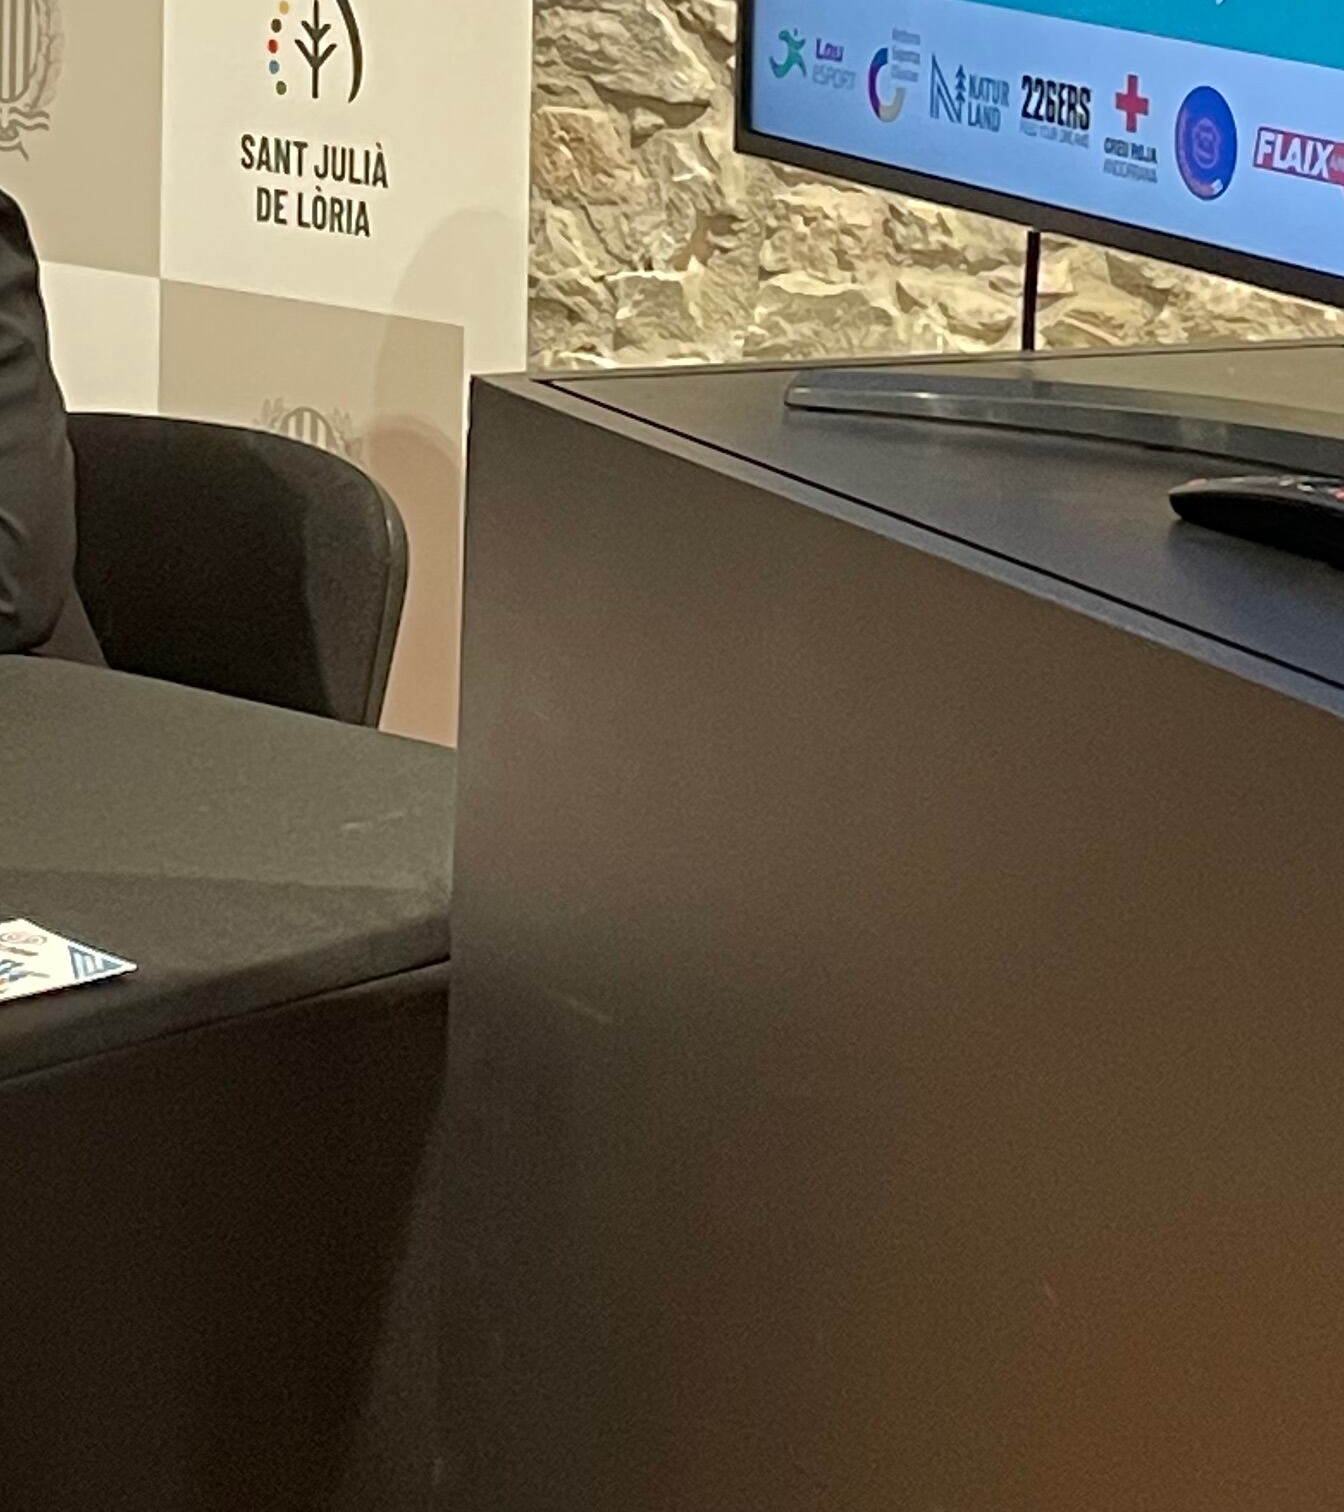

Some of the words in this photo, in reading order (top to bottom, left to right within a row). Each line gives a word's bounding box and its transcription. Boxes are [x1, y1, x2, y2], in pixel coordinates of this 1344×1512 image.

[968, 73, 1010, 108] NATUR
[1021, 74, 1092, 131] 226ERS
[967, 102, 1001, 133] LAND
[239, 133, 309, 180] SANT
[312, 142, 389, 189] JULIÀ
[1255, 129, 1335, 180] FLAIX
[255, 187, 289, 227] DE
[296, 185, 371, 238] LÒRIA
